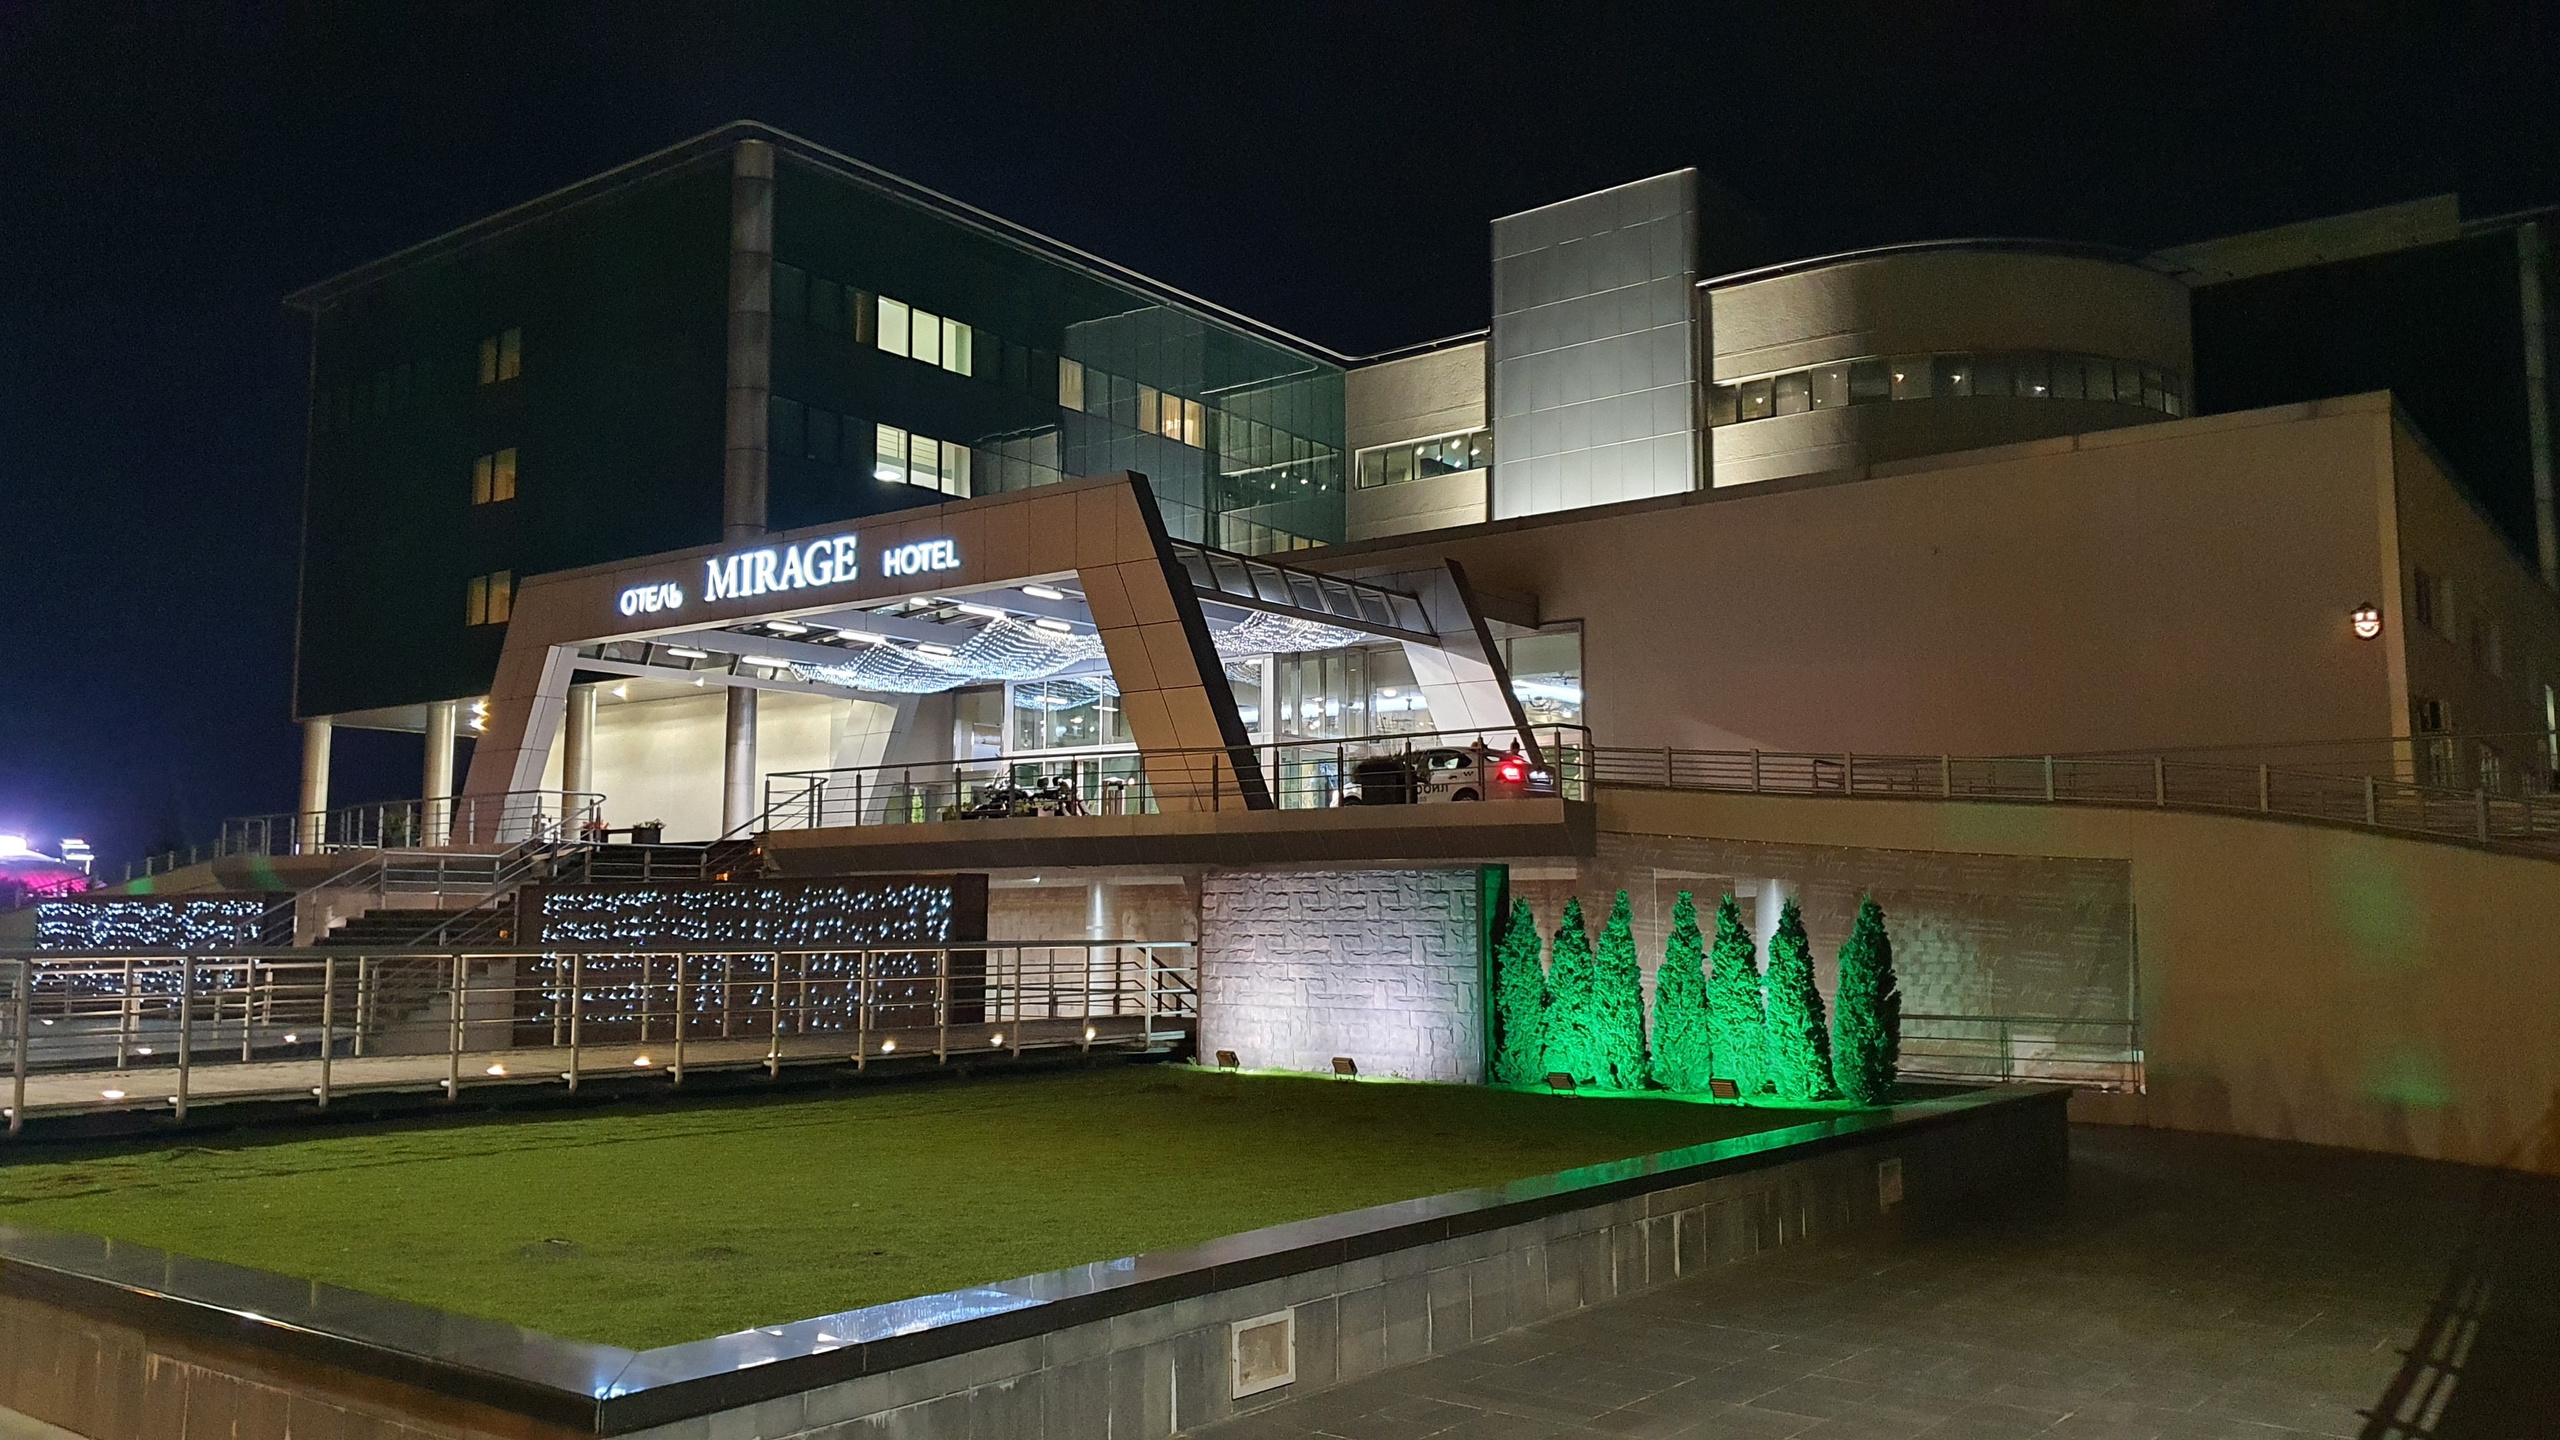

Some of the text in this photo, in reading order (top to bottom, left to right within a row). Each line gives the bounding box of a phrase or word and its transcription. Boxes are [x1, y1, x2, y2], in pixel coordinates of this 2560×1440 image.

[704, 535, 857, 601] MIRAGE
[883, 540, 960, 577] HOTEL
[620, 583, 683, 616] ОТЕЛЬ
